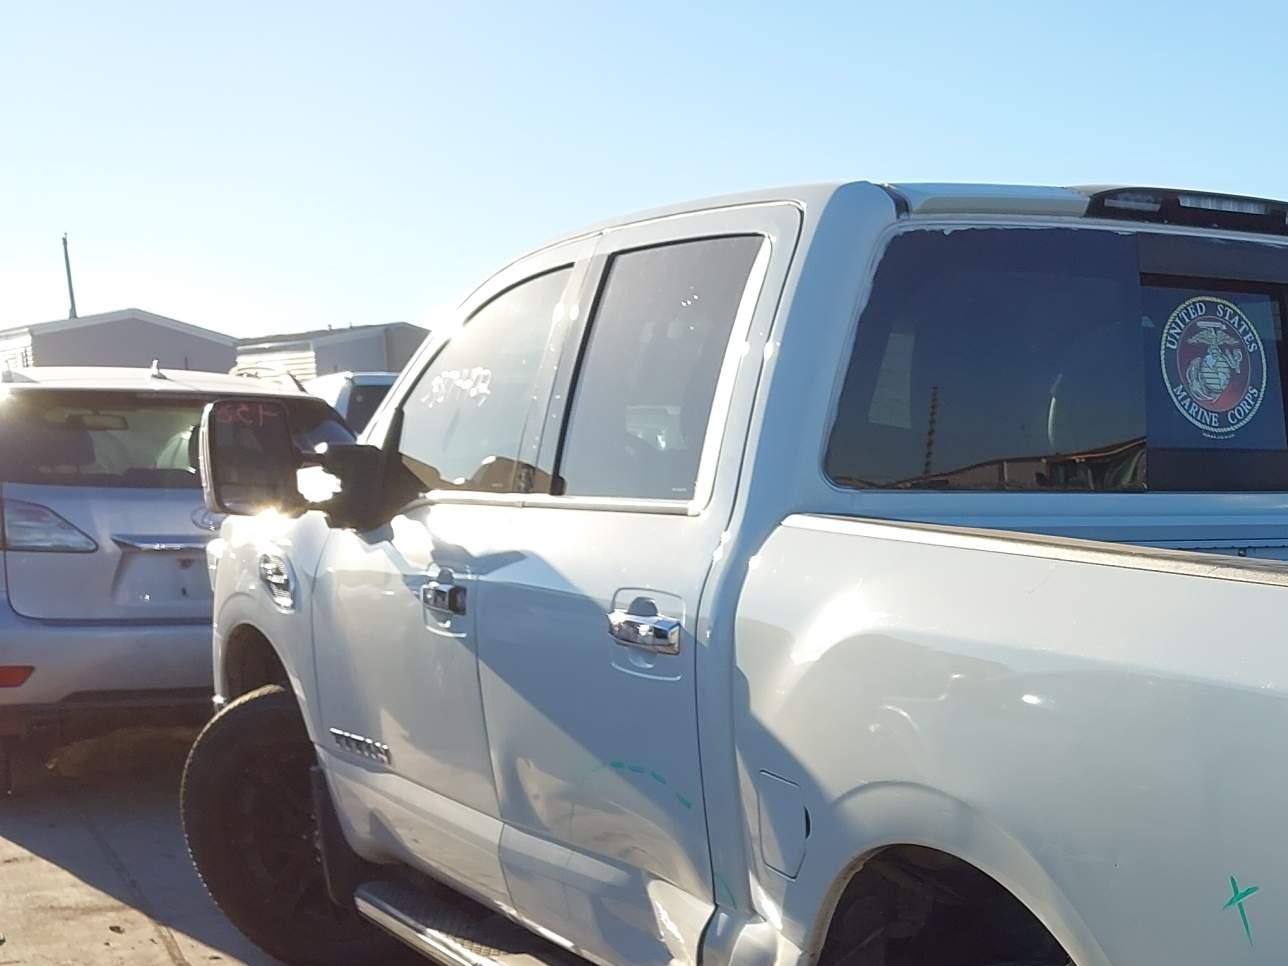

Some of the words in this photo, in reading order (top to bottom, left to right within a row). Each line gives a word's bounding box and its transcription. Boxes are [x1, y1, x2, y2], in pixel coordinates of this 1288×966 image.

[1166, 302, 1206, 350] UNITED
[1217, 304, 1258, 353] STATES
[1173, 385, 1219, 427] MARINE
[1227, 386, 1259, 425] CORPS
